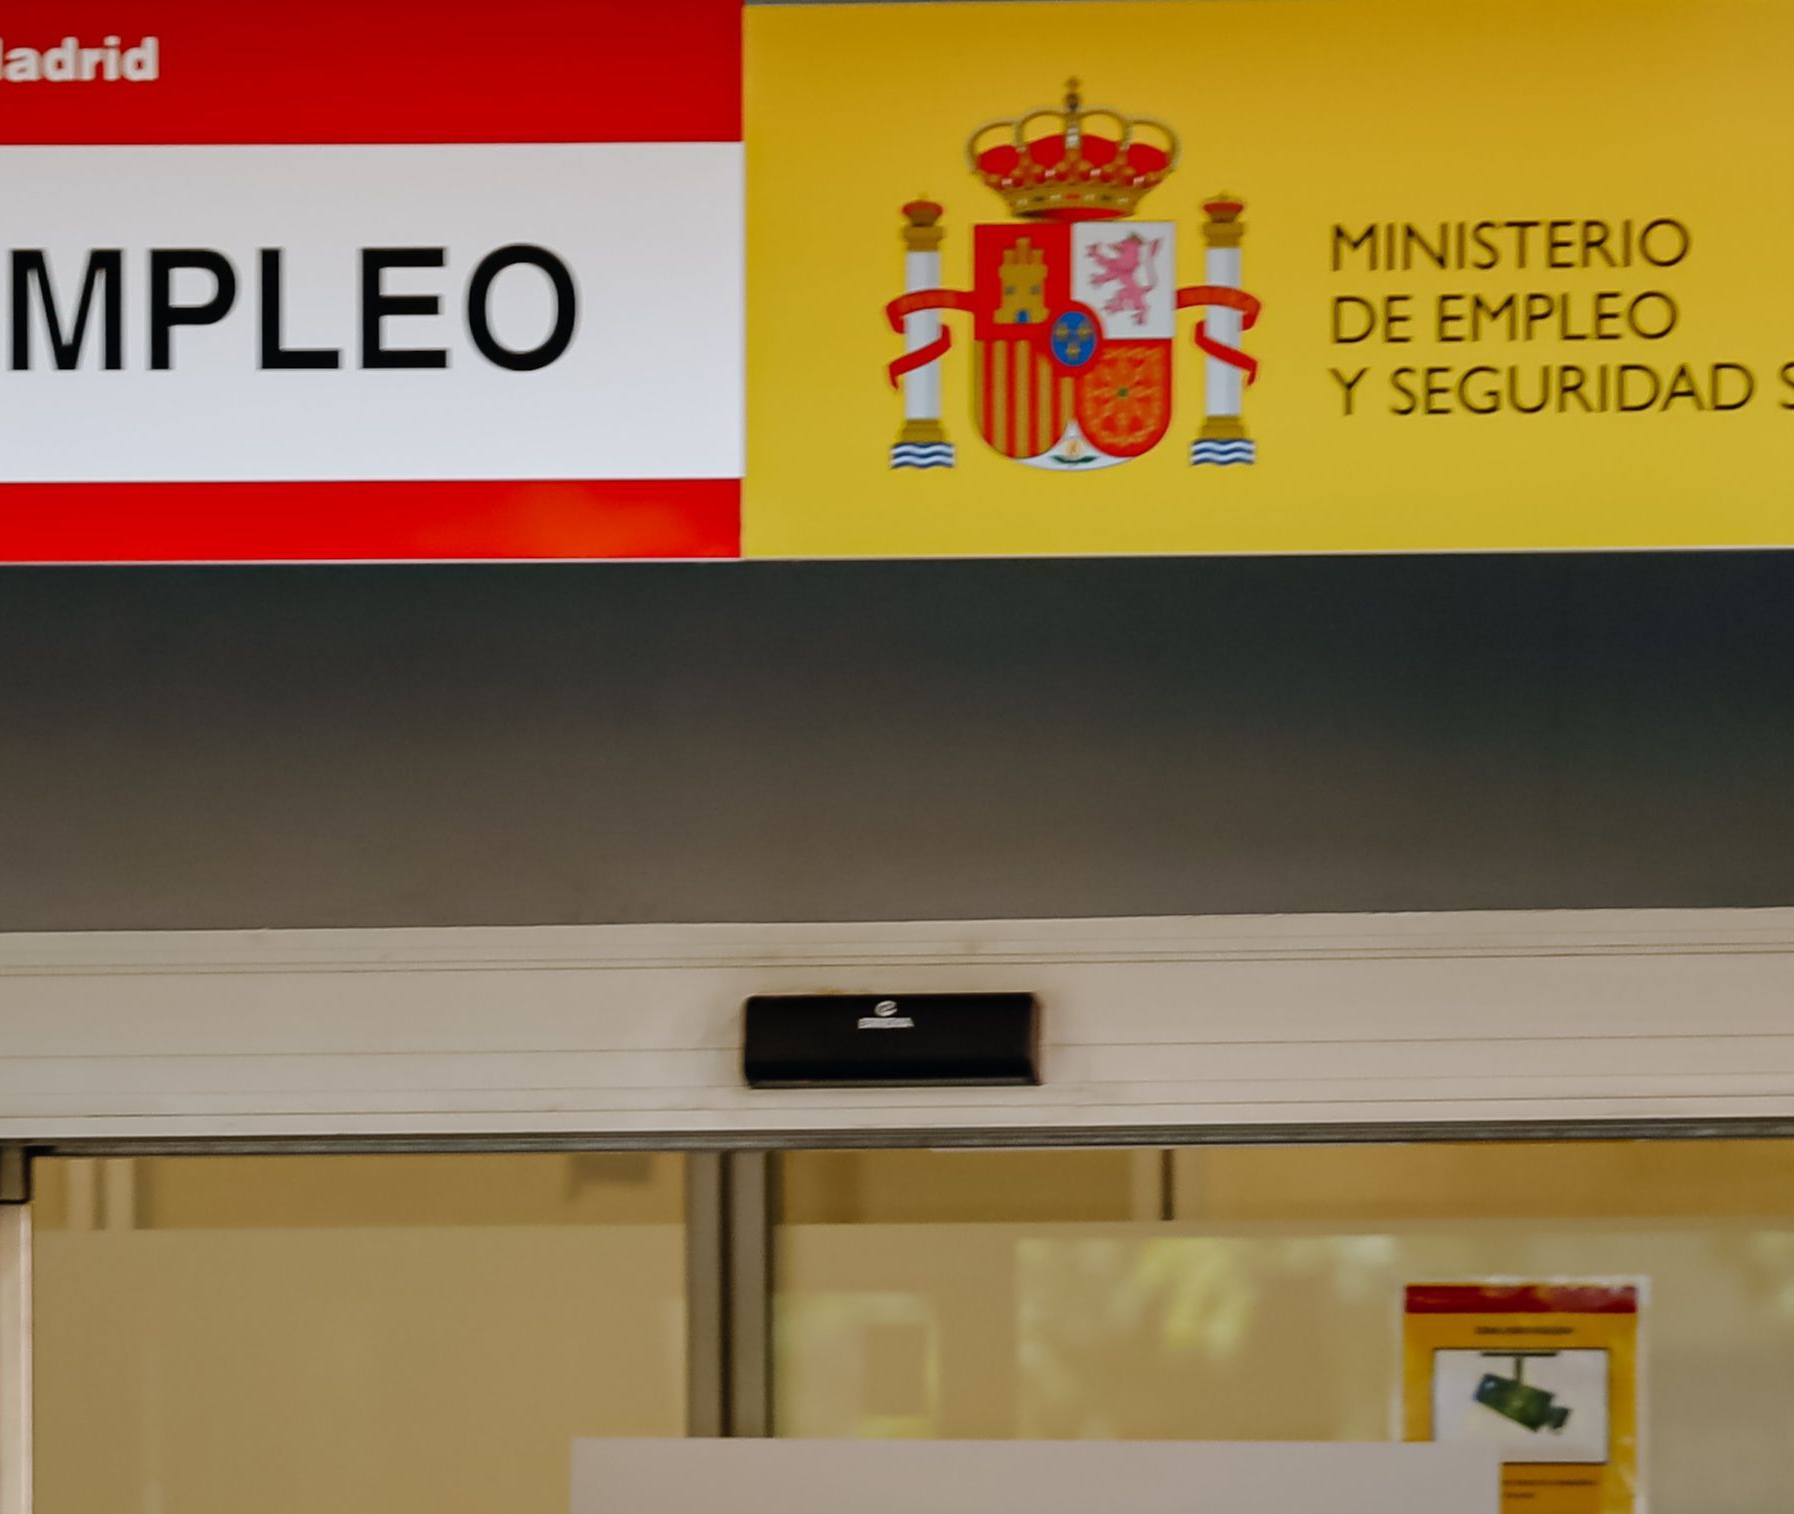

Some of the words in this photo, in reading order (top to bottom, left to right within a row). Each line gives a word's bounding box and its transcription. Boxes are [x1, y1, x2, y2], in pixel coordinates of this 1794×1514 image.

[1330, 215, 1693, 273] MINISTERIO
[1330, 291, 1413, 344] DE
[1435, 288, 1679, 343] EMPLEO
[1329, 366, 1369, 417] Y
[1389, 360, 1757, 417] SEGURIDAD
